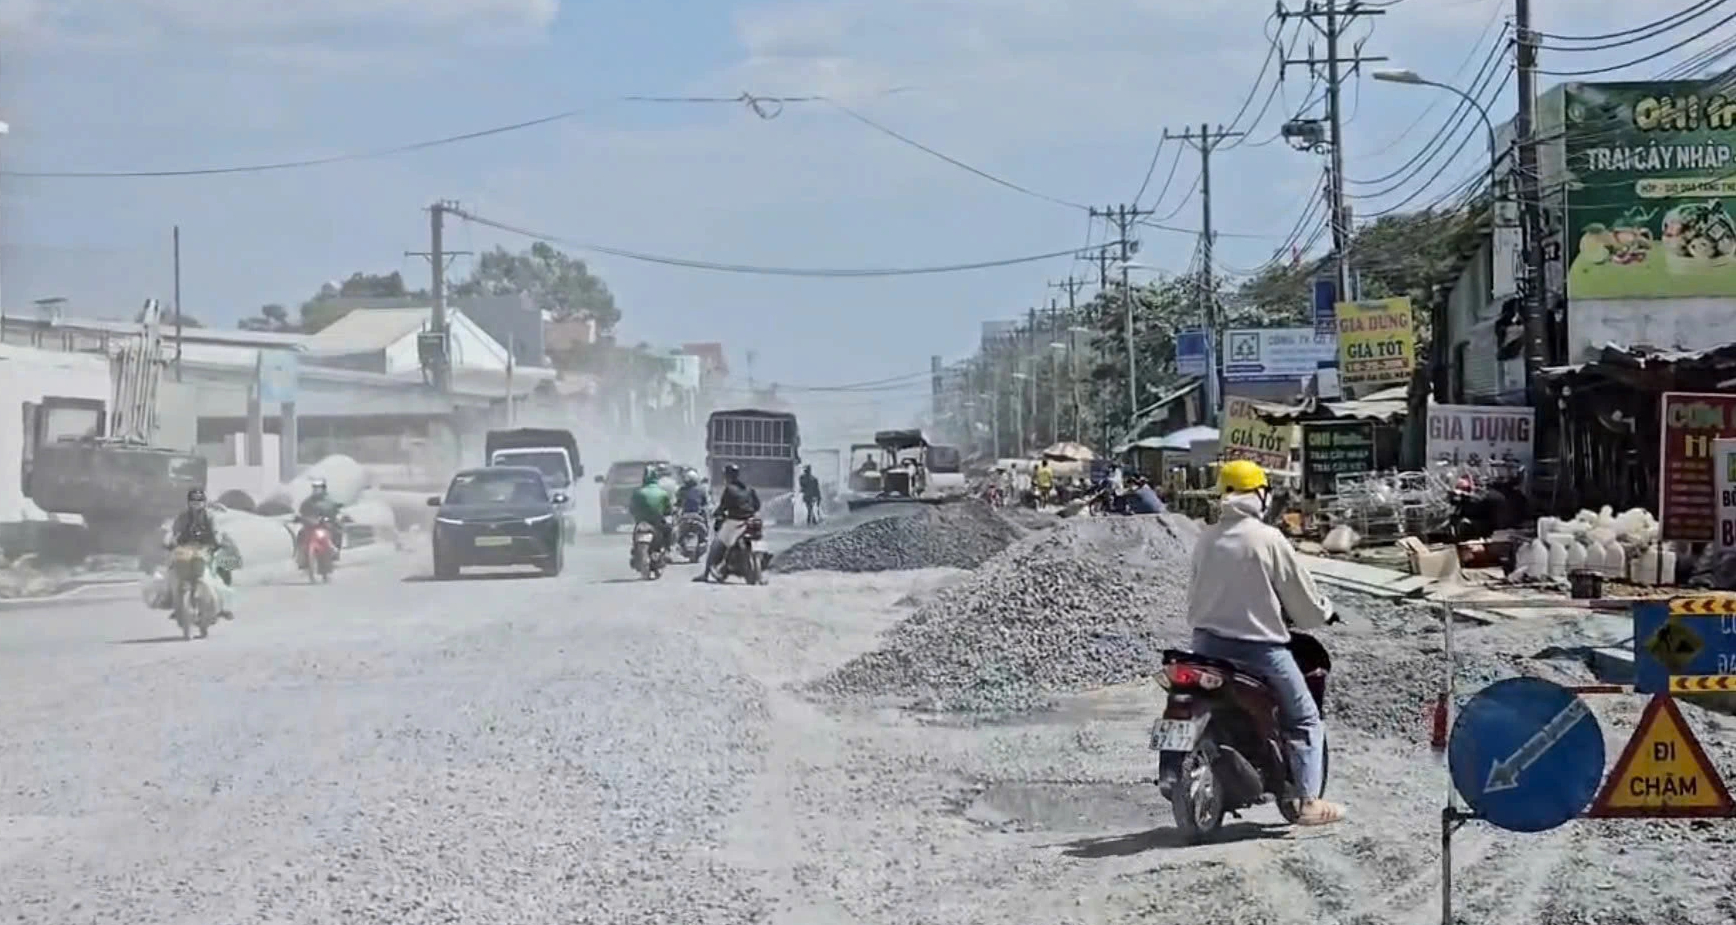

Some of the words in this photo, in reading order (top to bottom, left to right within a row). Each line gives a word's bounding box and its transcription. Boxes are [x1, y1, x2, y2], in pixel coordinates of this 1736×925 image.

[1676, 139, 1730, 173] NHẬP
[1348, 335, 1373, 358] GIÁ
[1377, 333, 1404, 356] TỐT
[1231, 425, 1253, 447] GIÁ
[1429, 415, 1464, 441] GIA
[1471, 415, 1530, 447] DỤNG
[1653, 741, 1676, 762] ĐI
[1630, 772, 1697, 801] CHẬM
